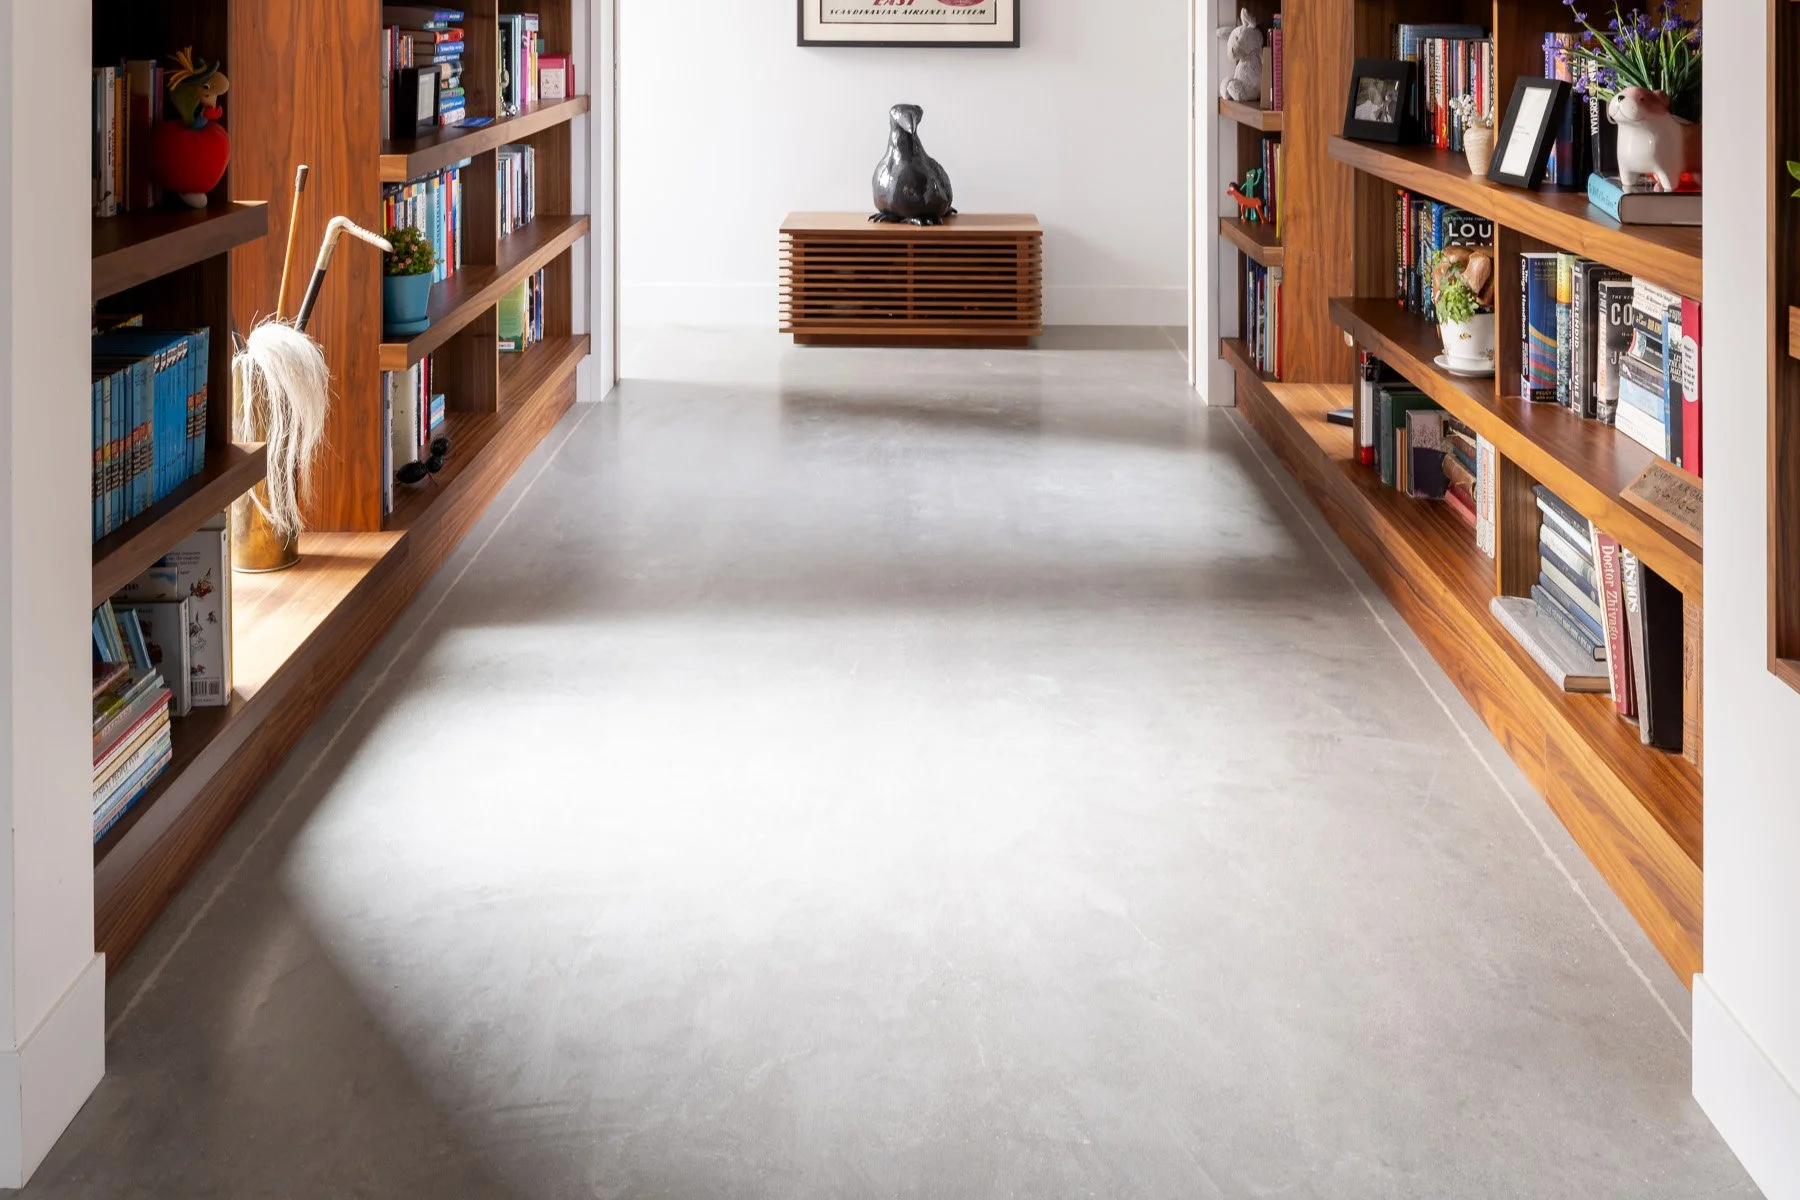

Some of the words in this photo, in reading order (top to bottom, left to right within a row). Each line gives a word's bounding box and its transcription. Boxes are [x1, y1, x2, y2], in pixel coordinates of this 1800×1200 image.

[1588, 95, 1598, 136] GRISHAM
[1448, 223, 1491, 238] LOU
[1611, 303, 1633, 326] CO
[1601, 545, 1615, 587] Doctor
[1623, 548, 1640, 614] COSMOS
[1606, 591, 1618, 640] Zhivago
